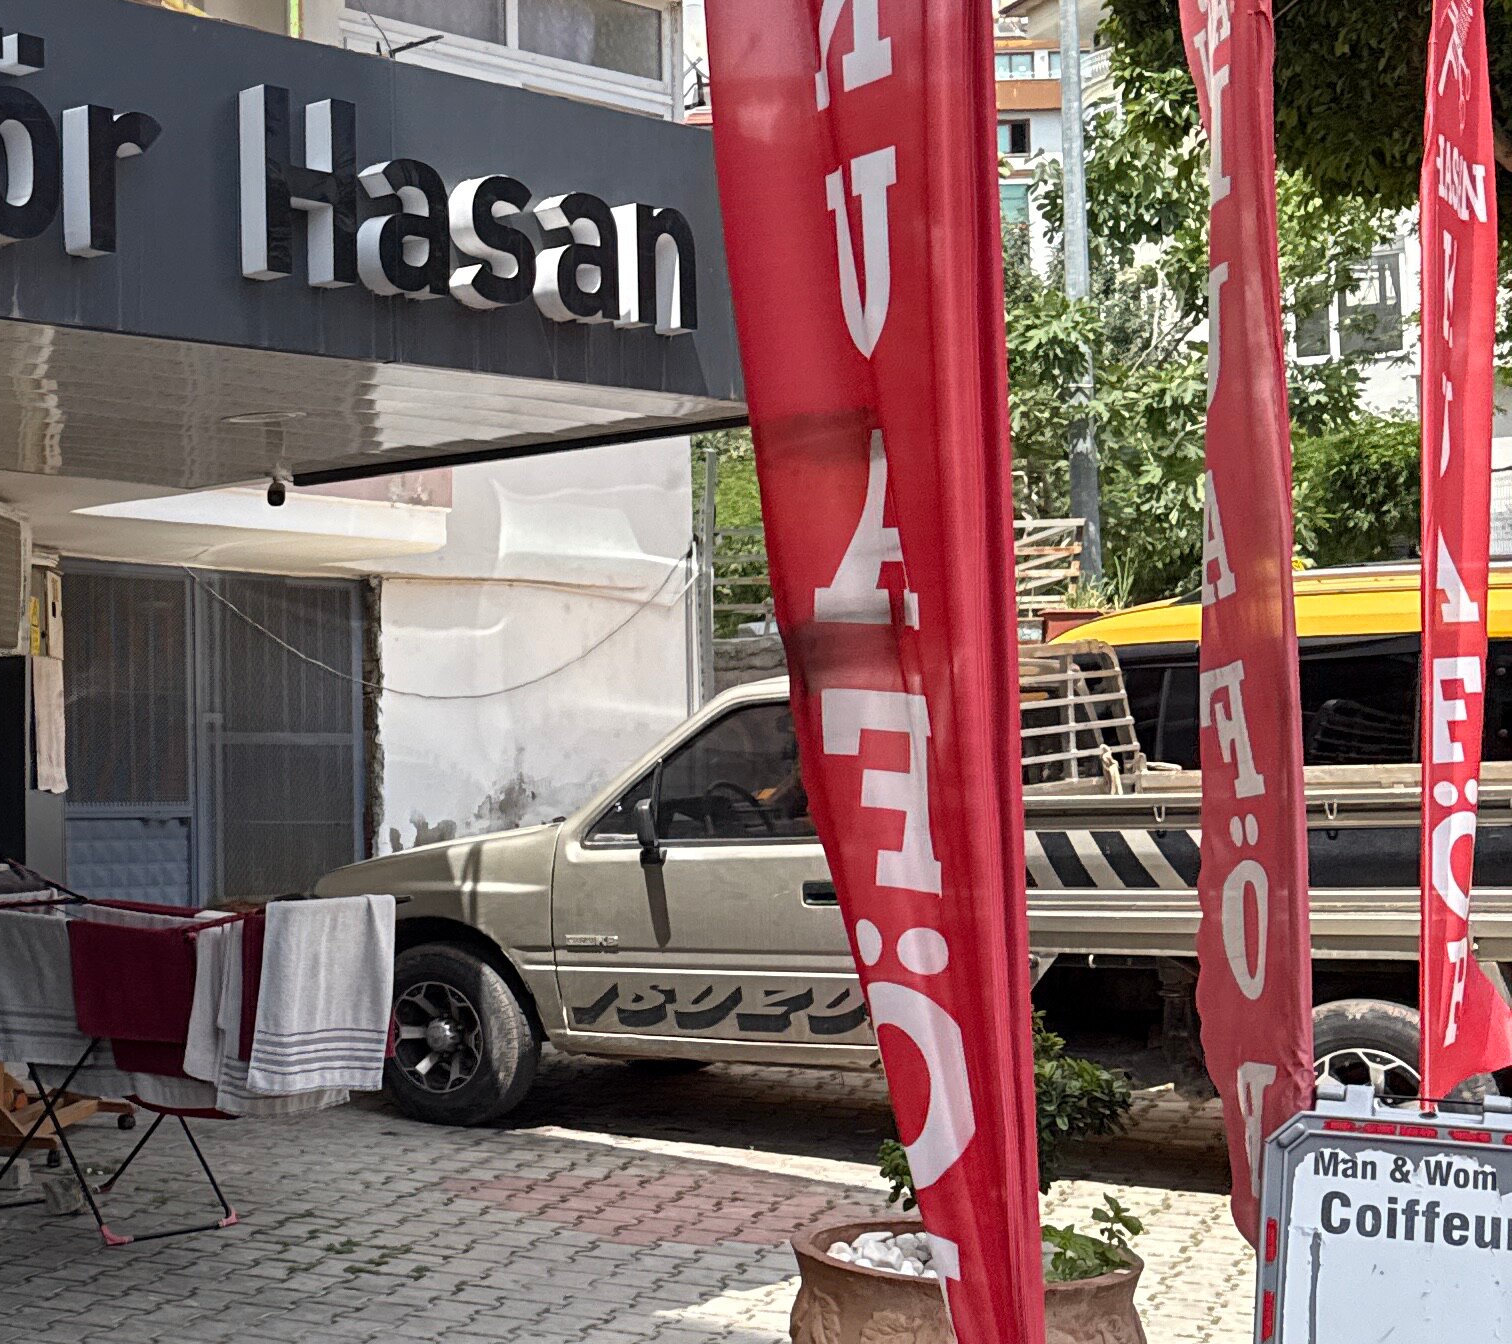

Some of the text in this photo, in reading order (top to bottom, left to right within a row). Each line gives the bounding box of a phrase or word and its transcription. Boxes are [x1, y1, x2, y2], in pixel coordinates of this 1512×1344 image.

[239, 84, 697, 336] Hasan
[572, 980, 870, 1036] ISUZU
[1313, 1150, 1377, 1181] Man
[1389, 1156, 1412, 1184] &
